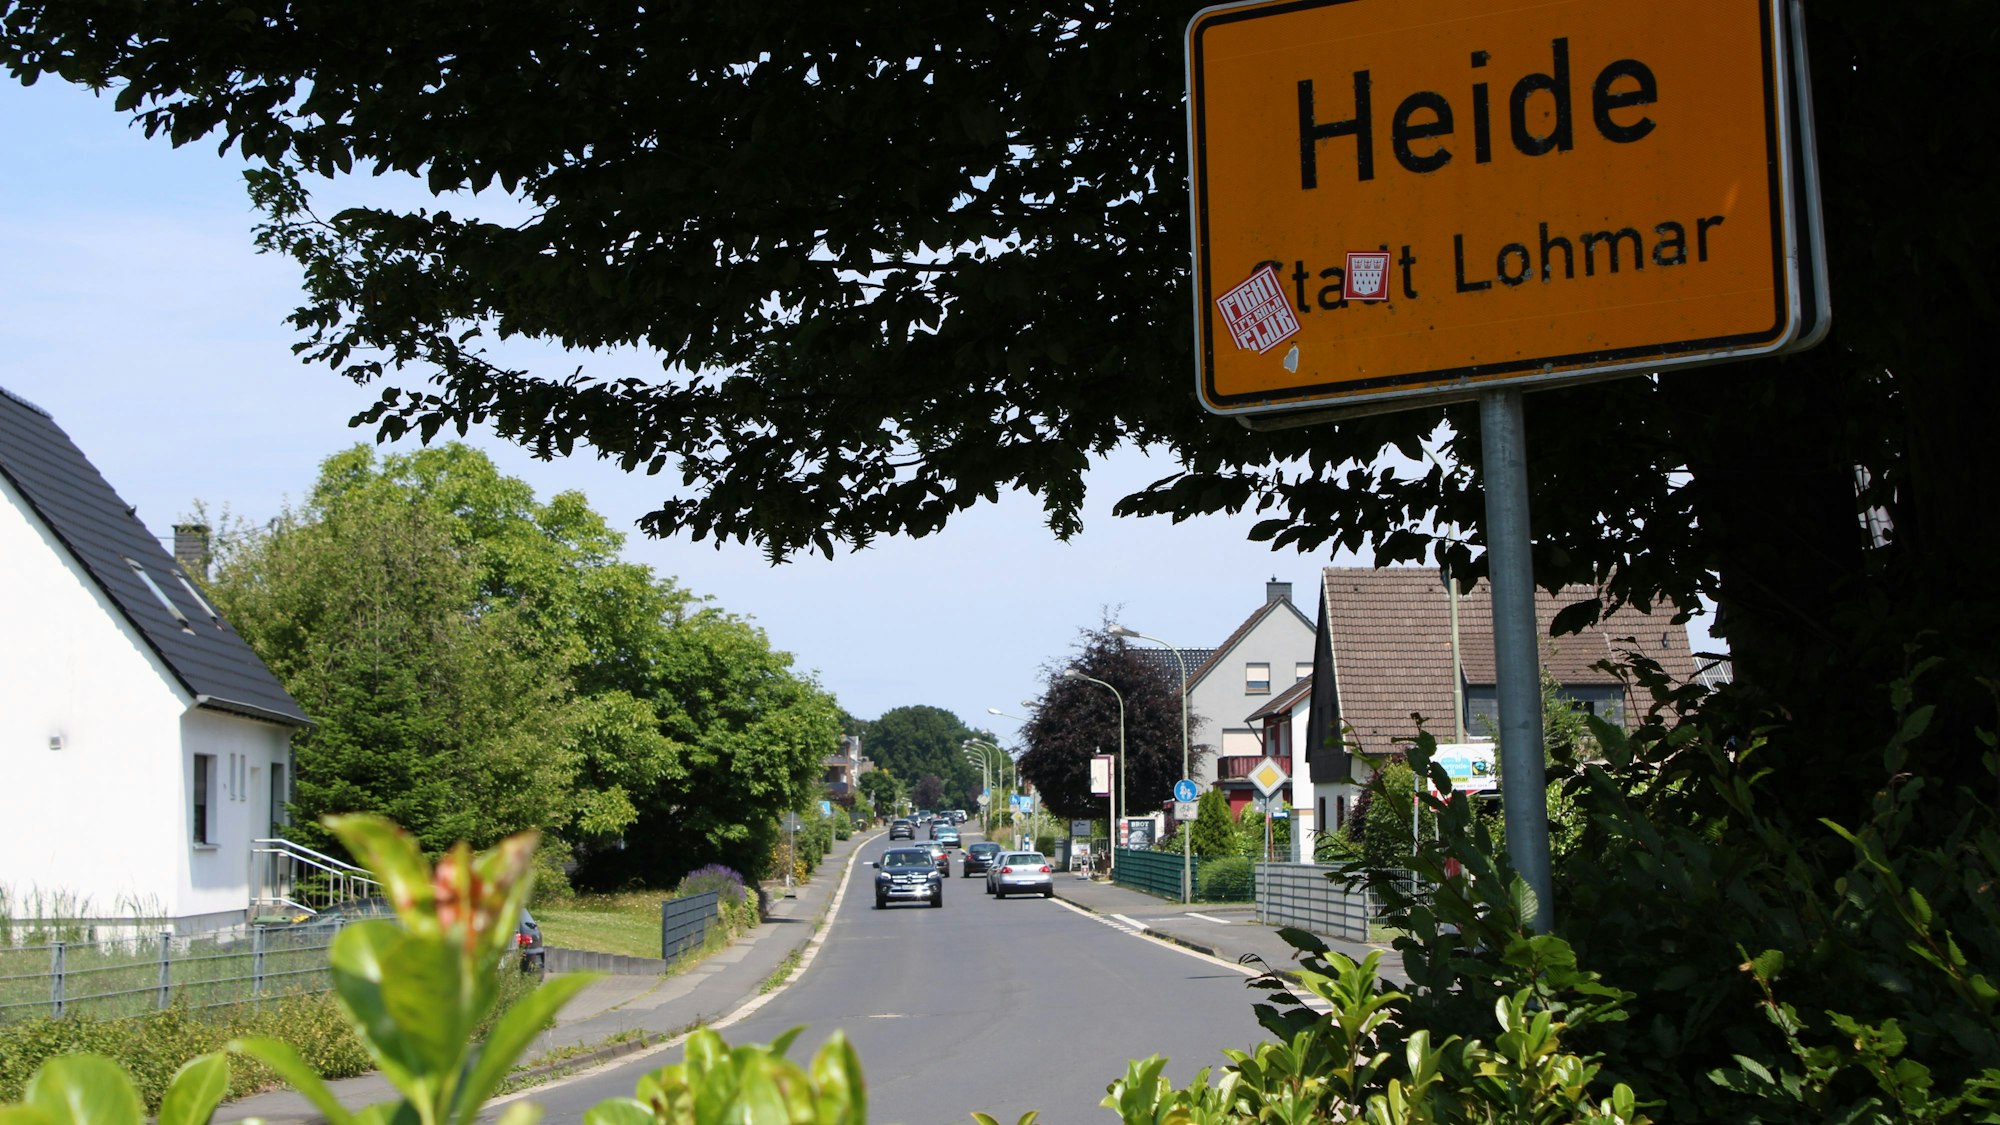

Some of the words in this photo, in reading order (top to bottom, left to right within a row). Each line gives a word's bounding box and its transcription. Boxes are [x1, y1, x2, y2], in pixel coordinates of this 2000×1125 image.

[1297, 37, 1658, 191] Heide
[1220, 271, 1277, 322] FIGHT
[1251, 244, 1419, 315] tat
[1453, 214, 1726, 295] Lohmar
